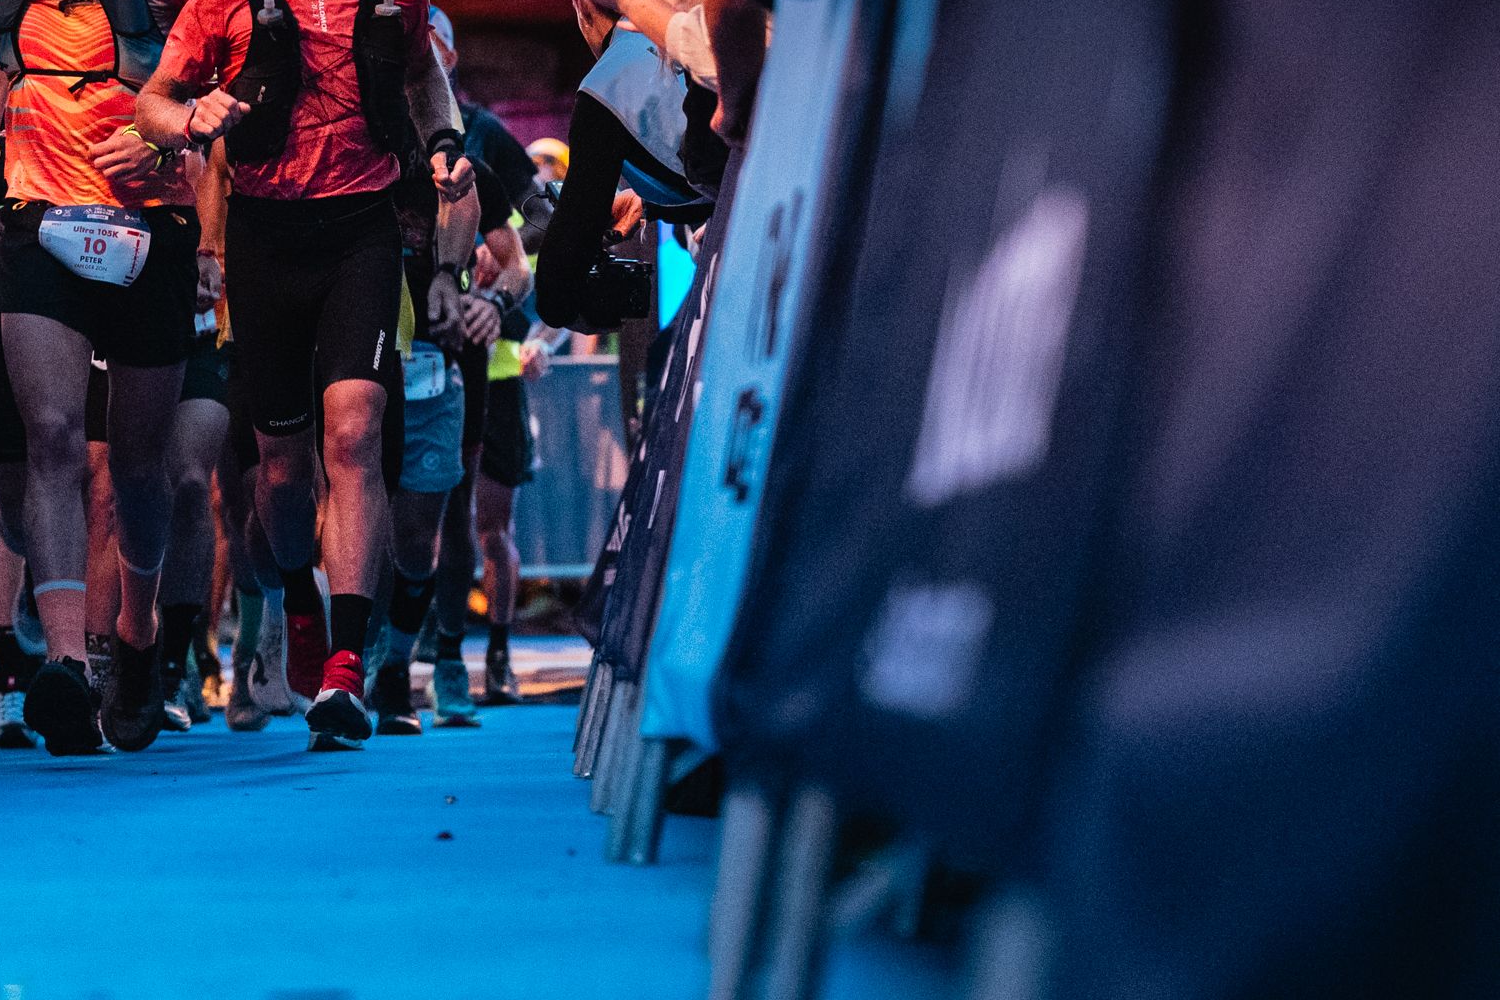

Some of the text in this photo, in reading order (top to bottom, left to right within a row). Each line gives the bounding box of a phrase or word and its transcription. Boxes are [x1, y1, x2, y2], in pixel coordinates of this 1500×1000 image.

[73, 225, 119, 238] Ultra 105K
[83, 236, 107, 255] 10
[79, 255, 103, 265] PETER
[372, 329, 386, 371] SALOMON
